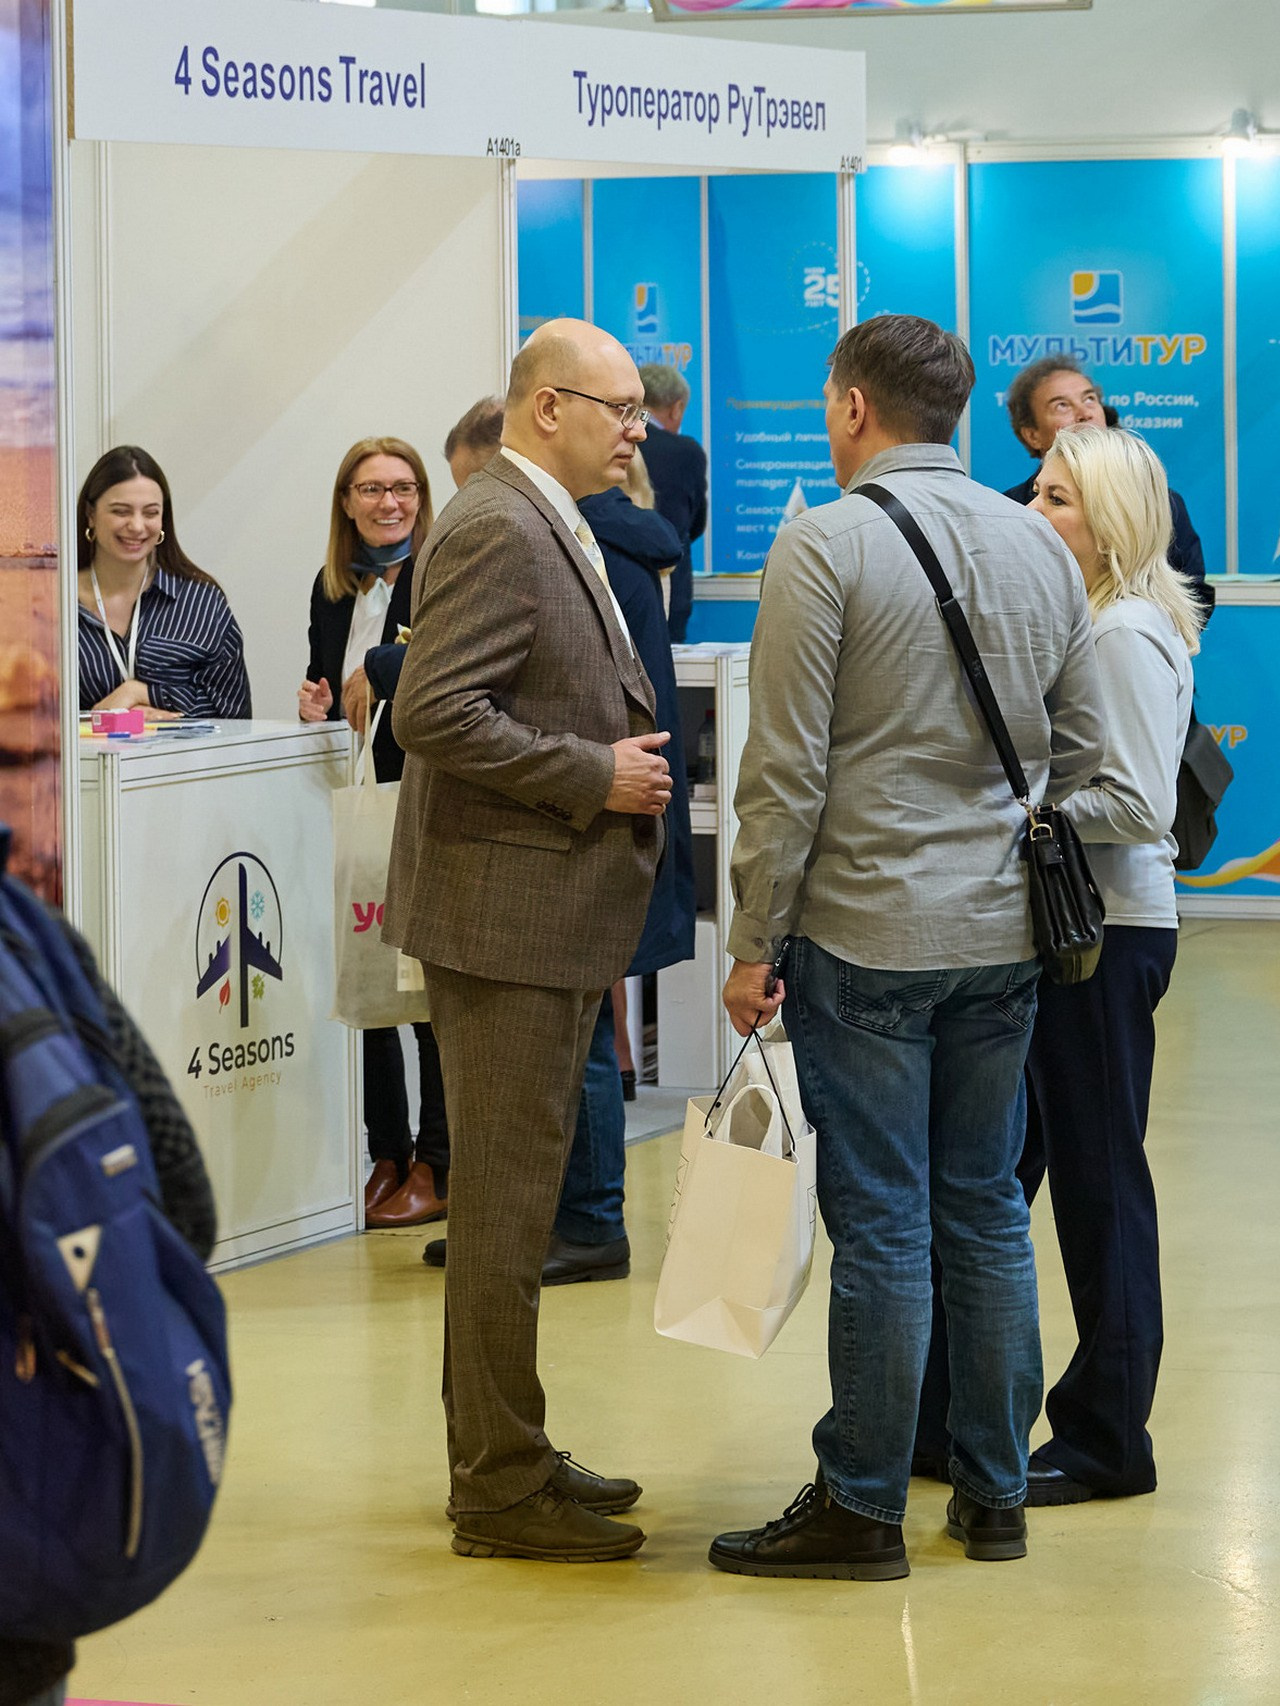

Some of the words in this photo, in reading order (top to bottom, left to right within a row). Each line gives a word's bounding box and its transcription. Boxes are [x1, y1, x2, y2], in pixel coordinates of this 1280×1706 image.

[174, 45, 192, 95] 4
[201, 46, 332, 102] Seasons
[339, 56, 425, 109] Travel
[573, 70, 720, 134] Туроператор
[727, 84, 826, 138] РуТрэвел
[1108, 395, 1130, 406] по
[1133, 391, 1200, 408] России,
[187, 1047, 202, 1079] 4
[208, 1032, 294, 1075] Seasons
[203, 1076, 237, 1099] Travel
[242, 1071, 281, 1091] Agency
